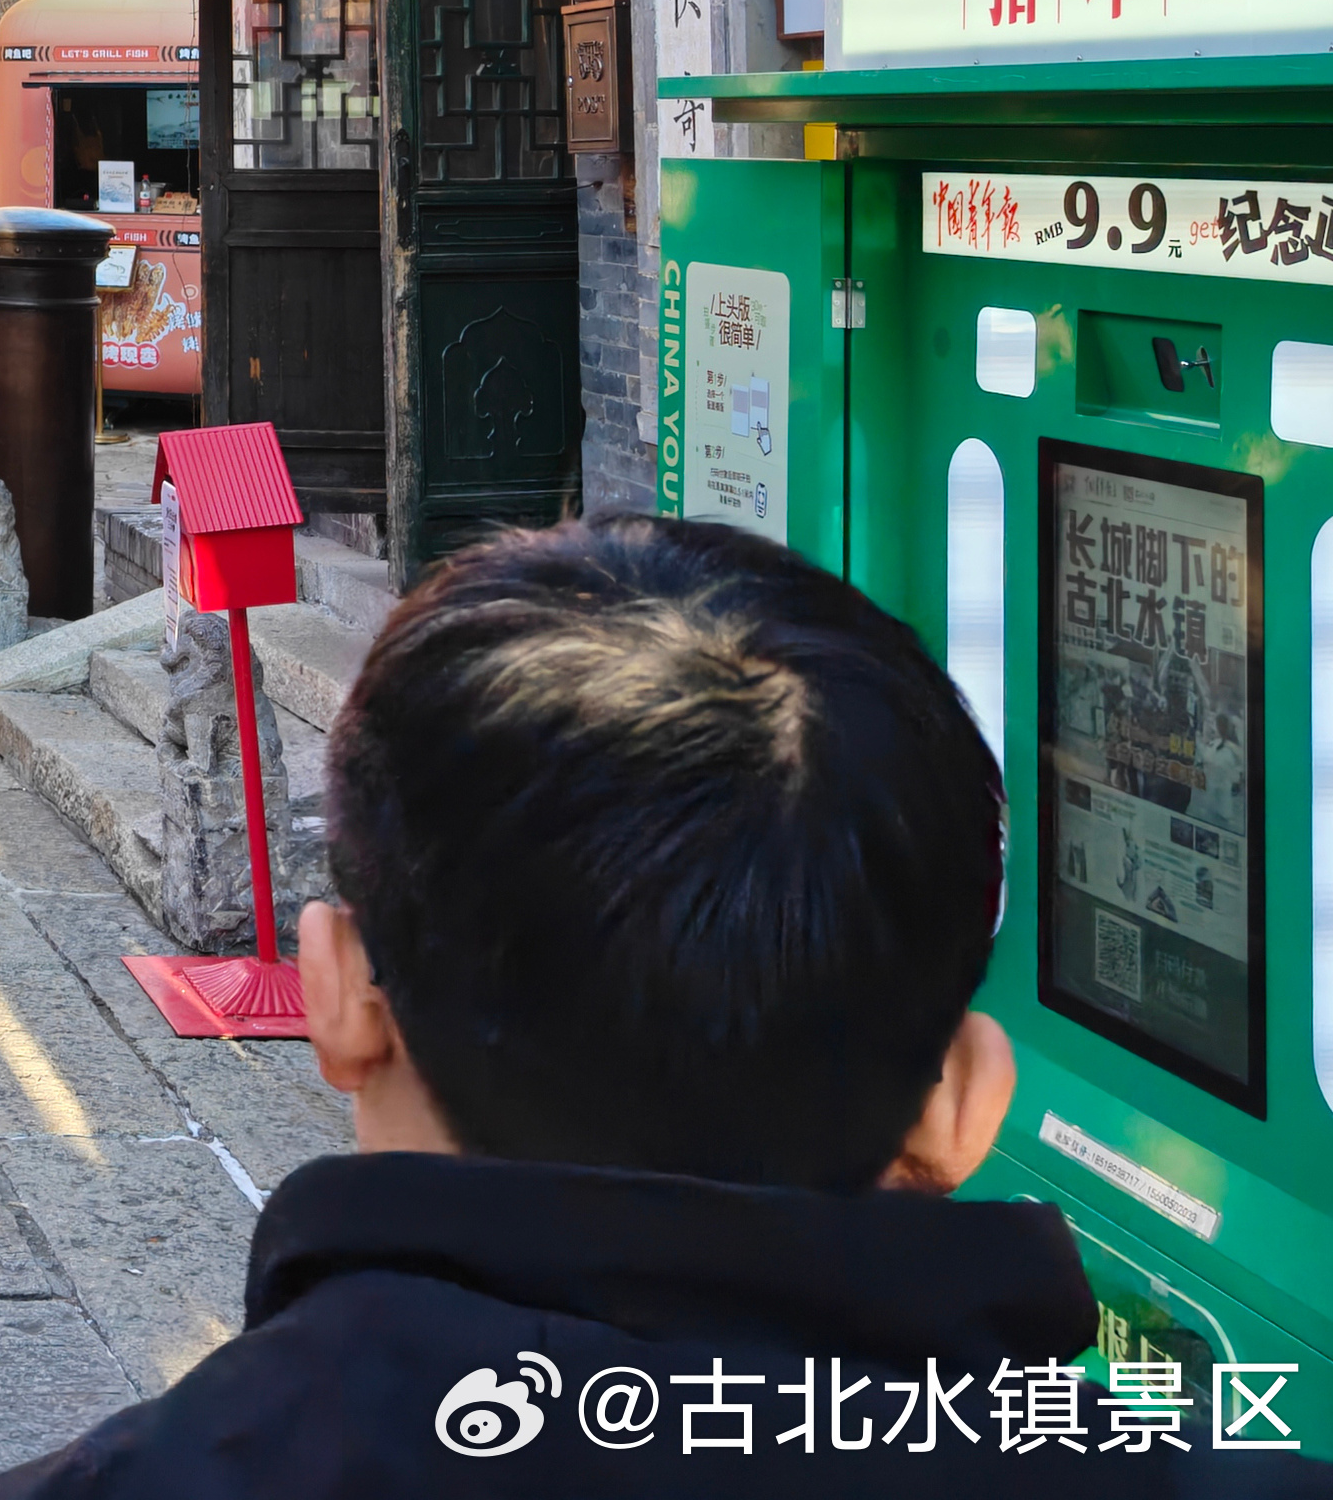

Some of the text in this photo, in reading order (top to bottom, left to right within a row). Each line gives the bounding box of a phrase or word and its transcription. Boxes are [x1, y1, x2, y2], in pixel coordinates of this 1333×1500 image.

[60, 48, 149, 59] LET'S GRILL FISH
[1034, 221, 1064, 246] RMB
[1190, 215, 1220, 246] get
[663, 259, 682, 397] CHINA
[1066, 508, 1246, 608] 长城脚下的
[1066, 570, 1209, 665] 古北水镇
